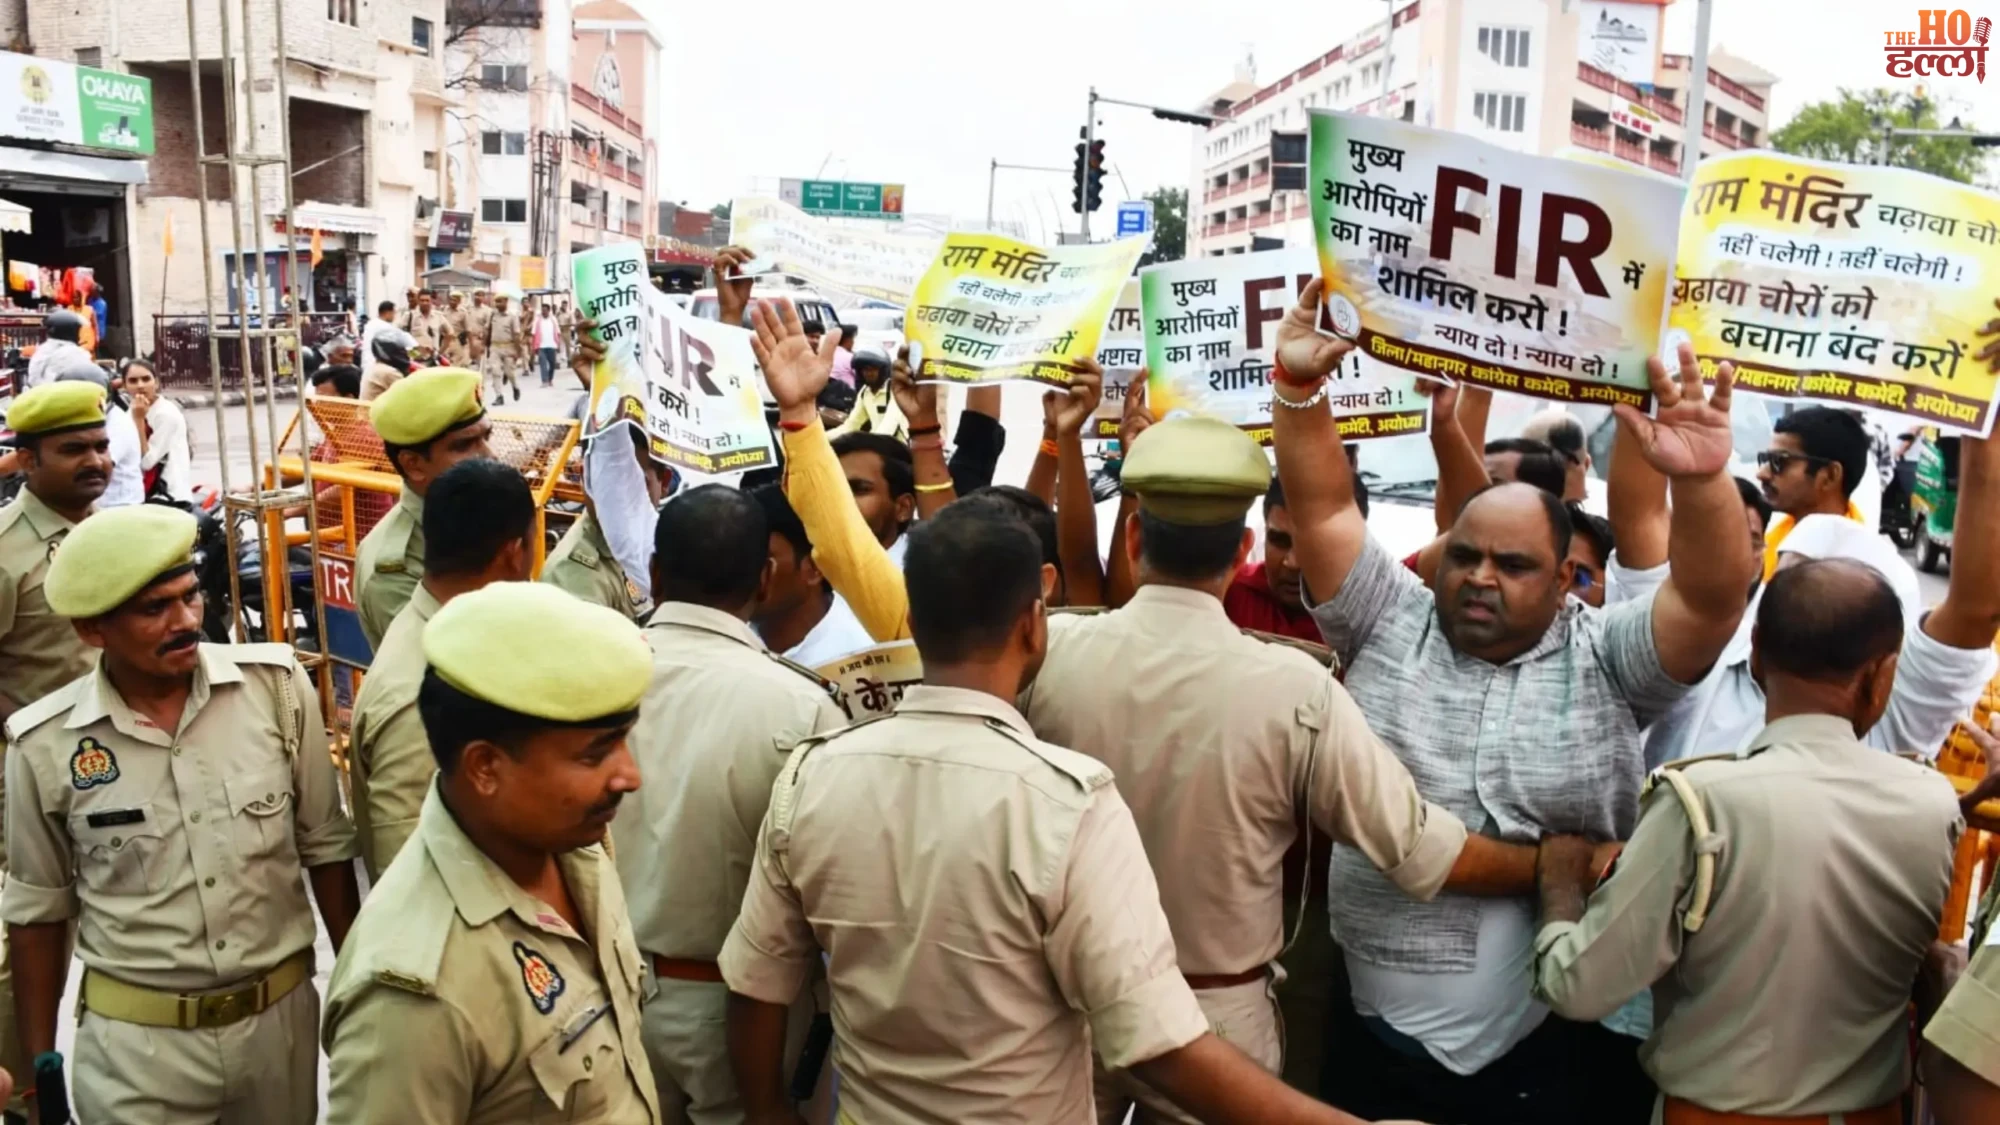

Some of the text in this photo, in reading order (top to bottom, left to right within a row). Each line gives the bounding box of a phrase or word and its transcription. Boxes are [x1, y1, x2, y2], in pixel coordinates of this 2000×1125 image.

[81, 75, 146, 105] OKAYA
[1348, 139, 1405, 172] मुख्य
[1323, 179, 1428, 225] आरोपियों
[1692, 177, 1749, 217] राम
[1760, 173, 1872, 229] मंदिर
[1878, 202, 1961, 238] चढ़ावा
[1331, 217, 1412, 259] का नाम
[1429, 165, 1612, 299] FIR
[942, 245, 989, 269] राम
[991, 247, 1060, 284] मंदिर
[1719, 233, 1759, 256] नहीं
[1760, 240, 1822, 268] चलेगी
[1839, 247, 1883, 269] नहीं
[1884, 252, 1955, 280] चलेगी
[1171, 278, 1217, 306] मुख्य
[1622, 260, 1646, 290] में
[981, 285, 1023, 306] चलेगी
[1377, 265, 1569, 337] शामिल करो !
[1758, 279, 1829, 318] चोरों
[1831, 286, 1879, 321] को
[600, 318, 623, 342] का
[916, 305, 970, 328] चढ़ावा
[972, 310, 1018, 336] चोरों
[1155, 305, 1241, 336] आरोपियों
[942, 333, 1004, 361] बचाना
[1166, 339, 1232, 364] का नाम
[1434, 324, 1619, 379] न्याय दो ! न्याय दो !
[1720, 318, 1969, 380] बचाना बंद करों
[1209, 358, 1276, 392] शामि
[1371, 337, 1467, 377] जिला/महानगर
[1471, 365, 1520, 388] कांग्रेस
[1580, 386, 1644, 407] अयोध्या
[658, 385, 690, 420] करो
[1333, 392, 1370, 409] न्याय
[1374, 386, 1394, 407] दो
[1912, 393, 1980, 423] अयोध्या
[714, 431, 733, 448] दो
[1377, 414, 1424, 434] अयोध्या
[320, 556, 354, 605] TR
[854, 677, 888, 712] के
